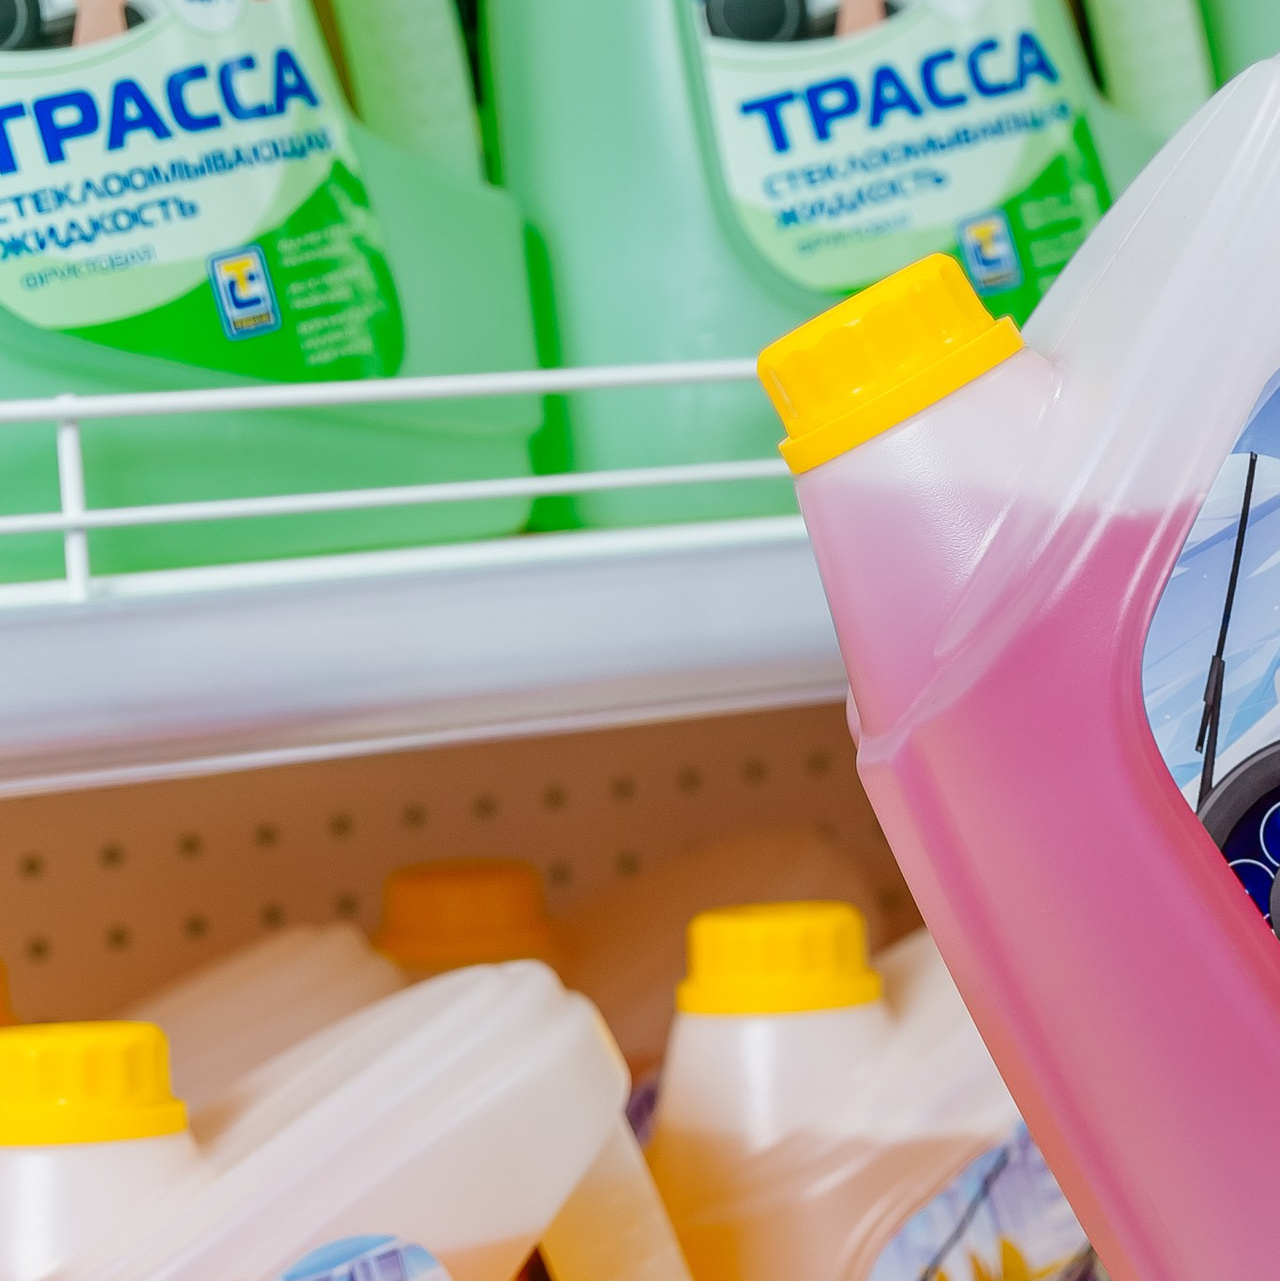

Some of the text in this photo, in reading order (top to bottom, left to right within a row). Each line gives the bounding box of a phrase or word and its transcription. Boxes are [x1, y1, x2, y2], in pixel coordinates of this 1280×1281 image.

[0, 47, 320, 176] ТРАССА
[741, 32, 1060, 152] ТРАССА
[0, 128, 332, 221] ТЕКЛООМЫВАЮЩАЯ
